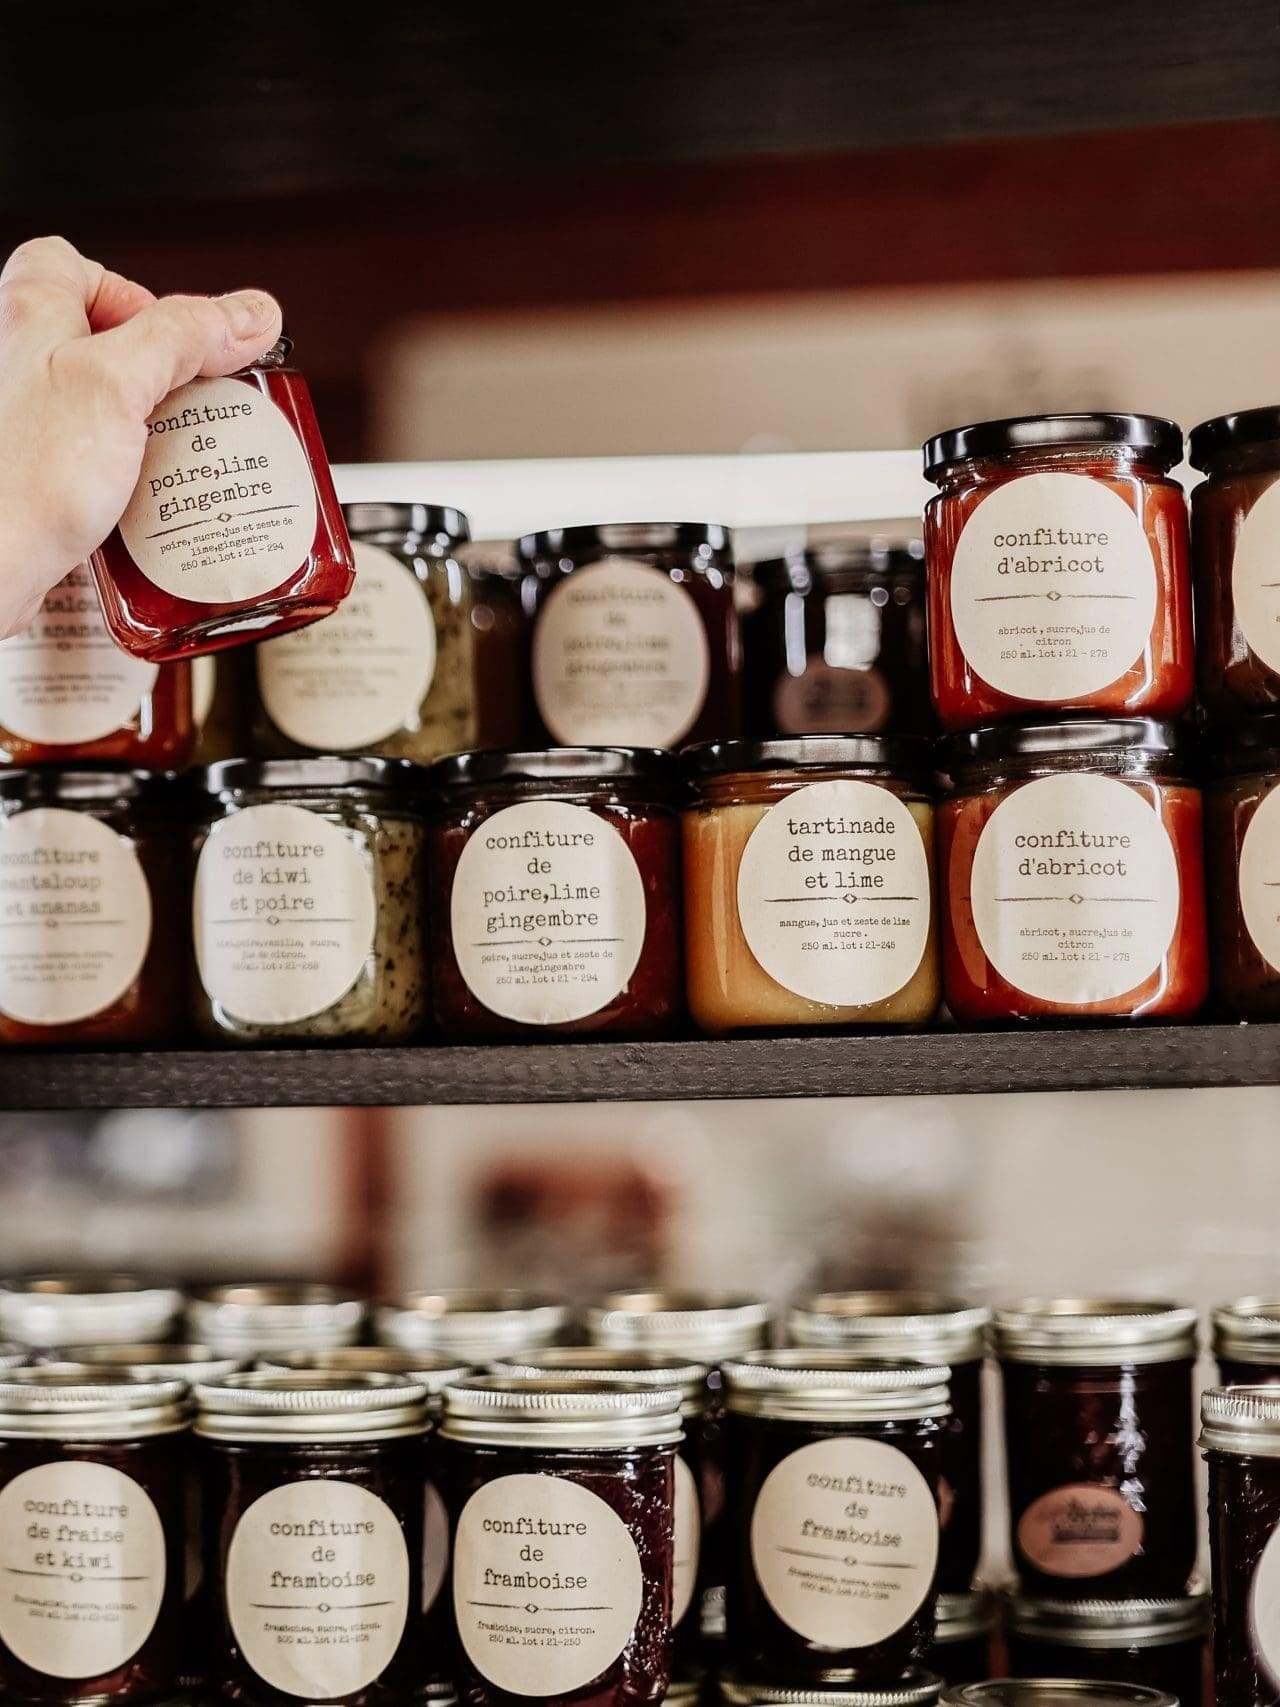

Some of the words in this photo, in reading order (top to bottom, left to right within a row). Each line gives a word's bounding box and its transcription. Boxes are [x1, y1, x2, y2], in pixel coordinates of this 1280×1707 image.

[146, 402, 253, 437] confiture
[191, 435, 217, 453] de
[149, 455, 269, 497] poire,lime
[159, 481, 273, 522] gingembre
[160, 538, 191, 554] poire,
[243, 523, 254, 533] et
[256, 519, 281, 530] zeste
[282, 517, 293, 526] de
[993, 527, 1109, 548] confiture
[180, 560, 198, 572] 250
[201, 556, 217, 567] ml.
[219, 551, 236, 562] lot
[244, 547, 257, 556] 21
[997, 556, 1105, 575] d'abricot
[1098, 625, 1111, 634] de
[1035, 637, 1072, 646] citron
[1000, 650, 1017, 659] 250
[1020, 650, 1036, 659] ml.
[1039, 649, 1056, 658] lot
[786, 817, 896, 836] tartinade
[485, 831, 595, 850] confiture
[1014, 830, 1132, 849] confiture
[222, 841, 325, 859] confiture
[787, 845, 814, 863] de
[821, 847, 896, 866] mangue
[526, 857, 552, 874] de
[1018, 858, 1128, 877] d'abricot
[232, 869, 254, 885] de
[260, 867, 311, 884] kiwi
[804, 872, 829, 889] et
[834, 871, 884, 889] lime
[230, 896, 249, 911] et
[255, 894, 315, 914] poire
[483, 883, 601, 908] poire,lime
[486, 910, 599, 934] gingembre
[779, 919, 820, 929] mangue,
[822, 917, 839, 928] jus
[841, 917, 852, 926] et
[854, 917, 879, 926] zeste
[881, 917, 892, 926] de
[893, 917, 911, 926] lime
[1120, 928, 1134, 937] de
[560, 951, 572, 959] et
[574, 950, 600, 959] zeste
[602, 949, 614, 959] de
[801, 941, 820, 951] 250
[822, 942, 838, 950] ml.
[841, 941, 857, 950] lot
[1057, 940, 1095, 949] citron
[1022, 952, 1040, 961] 250
[1042, 952, 1059, 961] ml.
[1061, 952, 1080, 961] lot
[532, 975, 549, 984] lot
[806, 1472, 908, 1498] confiture
[23, 1498, 130, 1518] confiture
[844, 1500, 870, 1520] de
[26, 1522, 51, 1540] de
[55, 1525, 126, 1544] fraise
[269, 1520, 376, 1537] confiture
[482, 1517, 588, 1536] confiture
[800, 1518, 903, 1548] framboise
[34, 1552, 56, 1567] et
[62, 1551, 114, 1569] kiwi
[311, 1545, 337, 1563] de
[519, 1545, 544, 1563] de
[269, 1570, 377, 1589] framboise
[483, 1568, 589, 1591] framboise
[558, 1626, 596, 1635] citron.
[522, 1637, 538, 1646] lot
